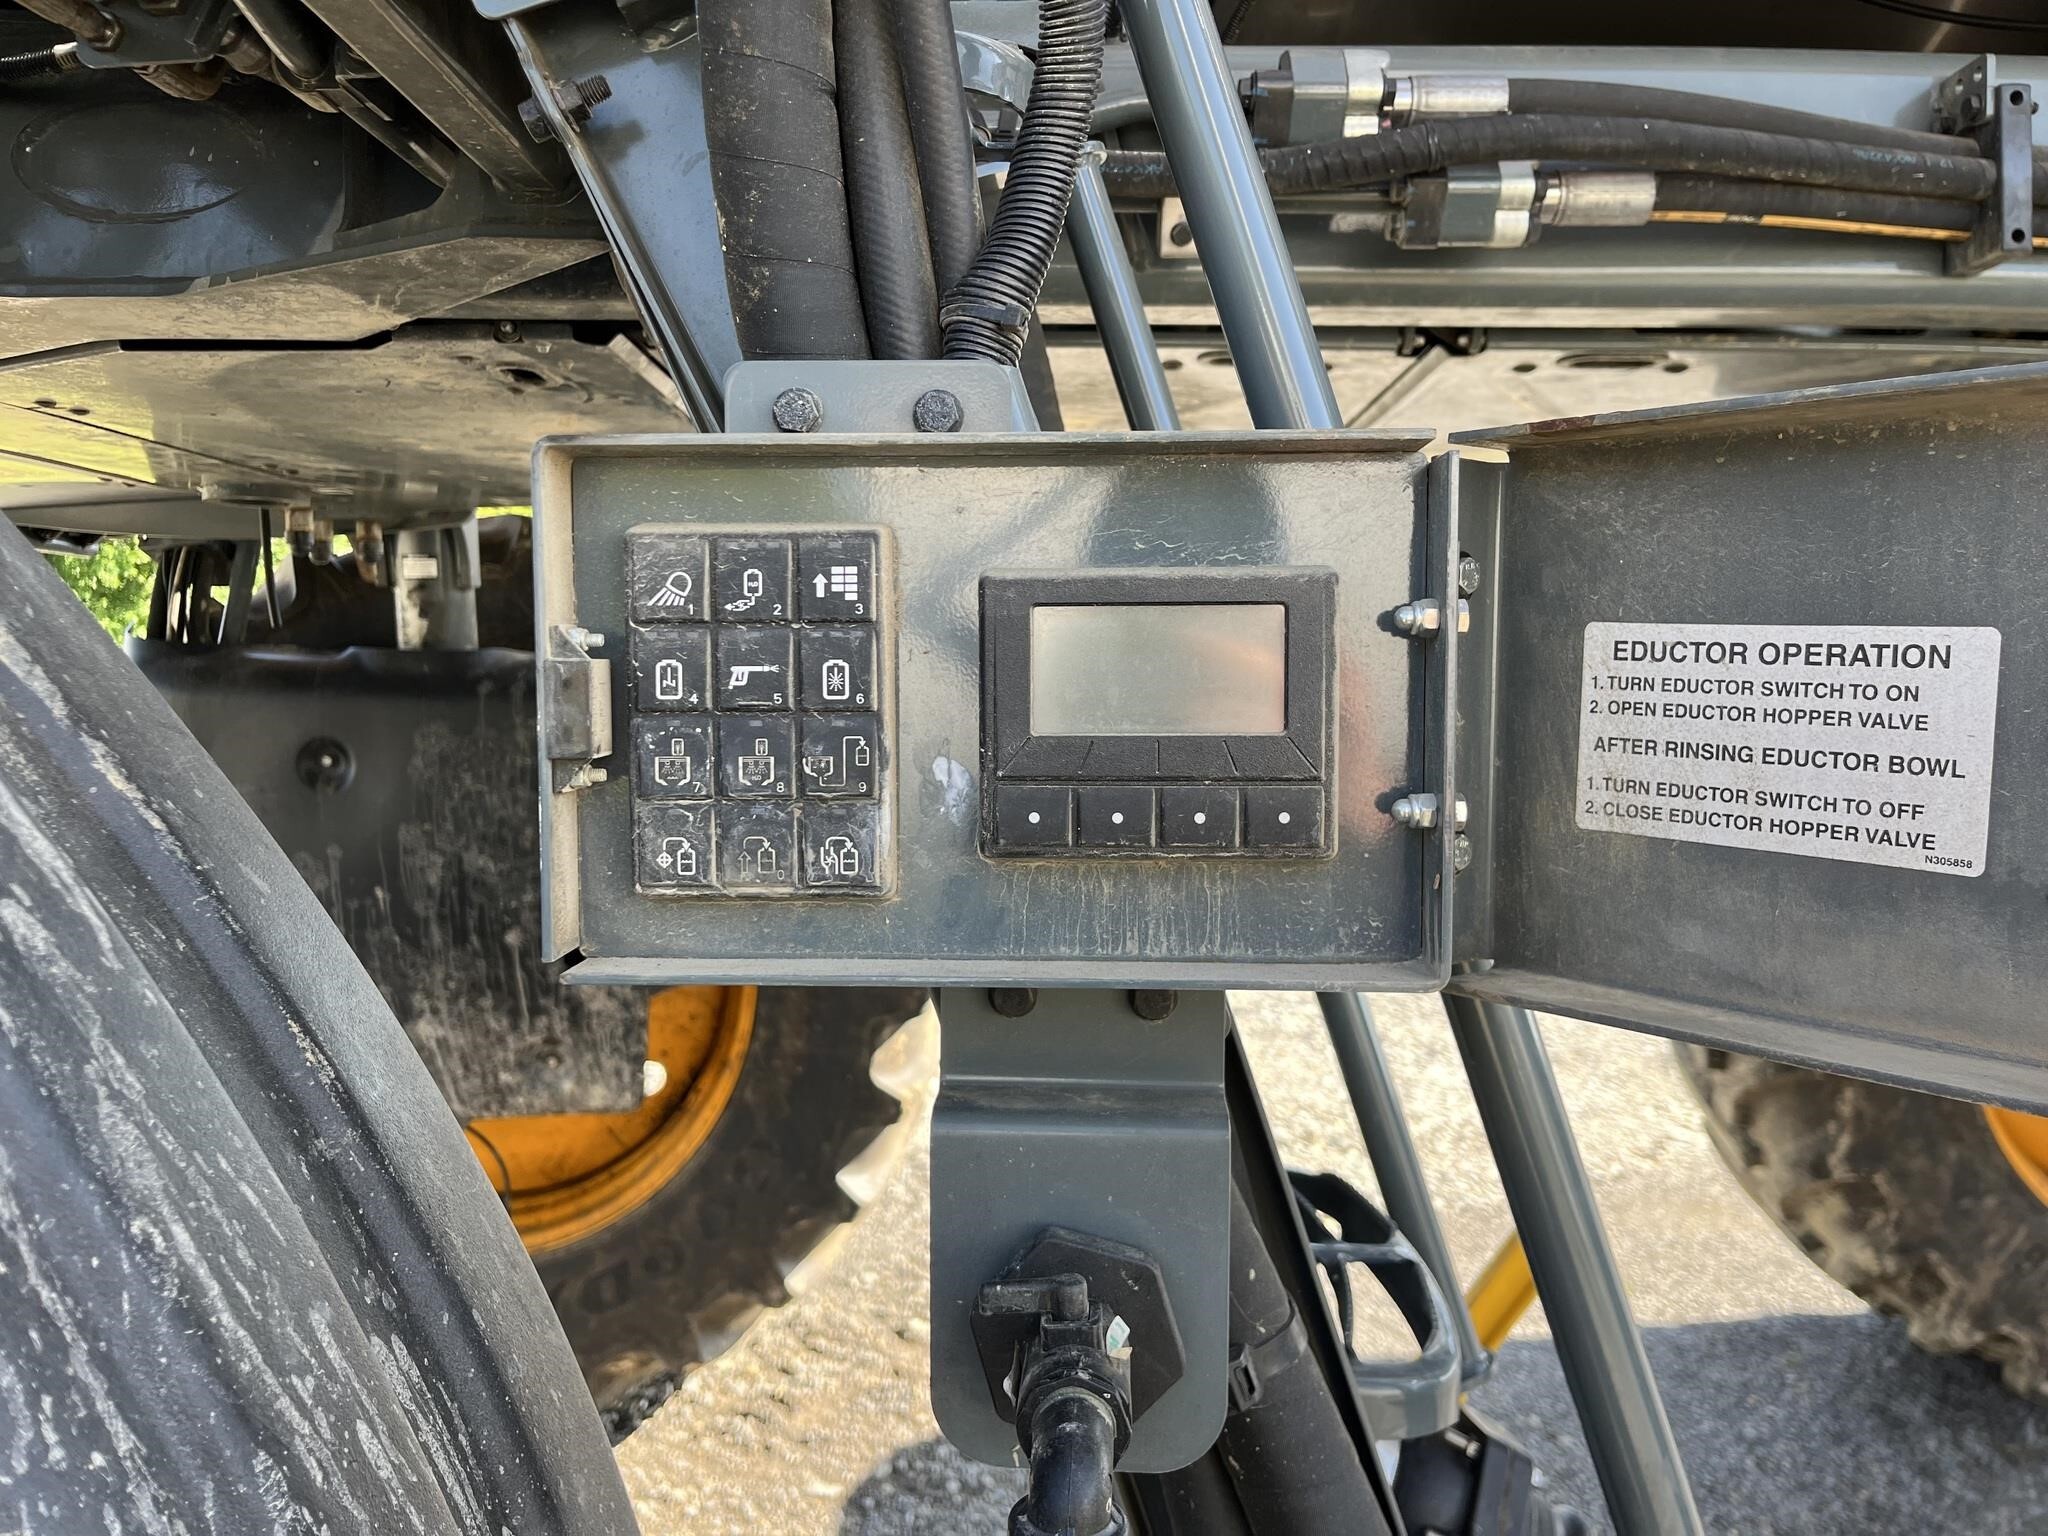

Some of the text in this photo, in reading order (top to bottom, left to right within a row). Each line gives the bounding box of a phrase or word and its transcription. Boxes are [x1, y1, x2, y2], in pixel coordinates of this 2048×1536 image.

[688, 604, 693, 615] 1
[773, 603, 782, 615] 2
[855, 603, 864, 614] 3
[1613, 640, 1951, 669] EDUCTOR OPERATION
[1607, 676, 1655, 692] TURN
[1661, 677, 1754, 696] EDUCTOR
[1760, 681, 1844, 699] SWITCH
[1848, 683, 1878, 701] TO
[1886, 684, 1919, 702] ON
[688, 693, 699, 704] 4
[773, 693, 782, 704] 5
[856, 693, 865, 704] 6
[1608, 700, 1657, 717] OPEN
[1663, 703, 1756, 722] EDUCTOR
[1763, 708, 1852, 727] HOPPER
[1858, 712, 1929, 731] VALVE
[1593, 736, 1966, 779] AFTER RINSING EDUCTOR BOWL
[692, 781, 701, 793] 7
[776, 782, 785, 793] 8
[858, 782, 867, 792] 9
[1602, 777, 1650, 795] TURN
[1656, 782, 1748, 805] EDUCTOR
[1754, 790, 1837, 813] SWITCH
[1842, 798, 1872, 816] TO
[1879, 801, 1925, 820] OFF
[1603, 802, 1663, 821] CLOSE
[1669, 808, 1763, 832] EDUCTOR
[1770, 818, 1859, 842] HOPPER
[1865, 827, 1936, 851] VALVE
[1925, 855, 1973, 869] N305858
